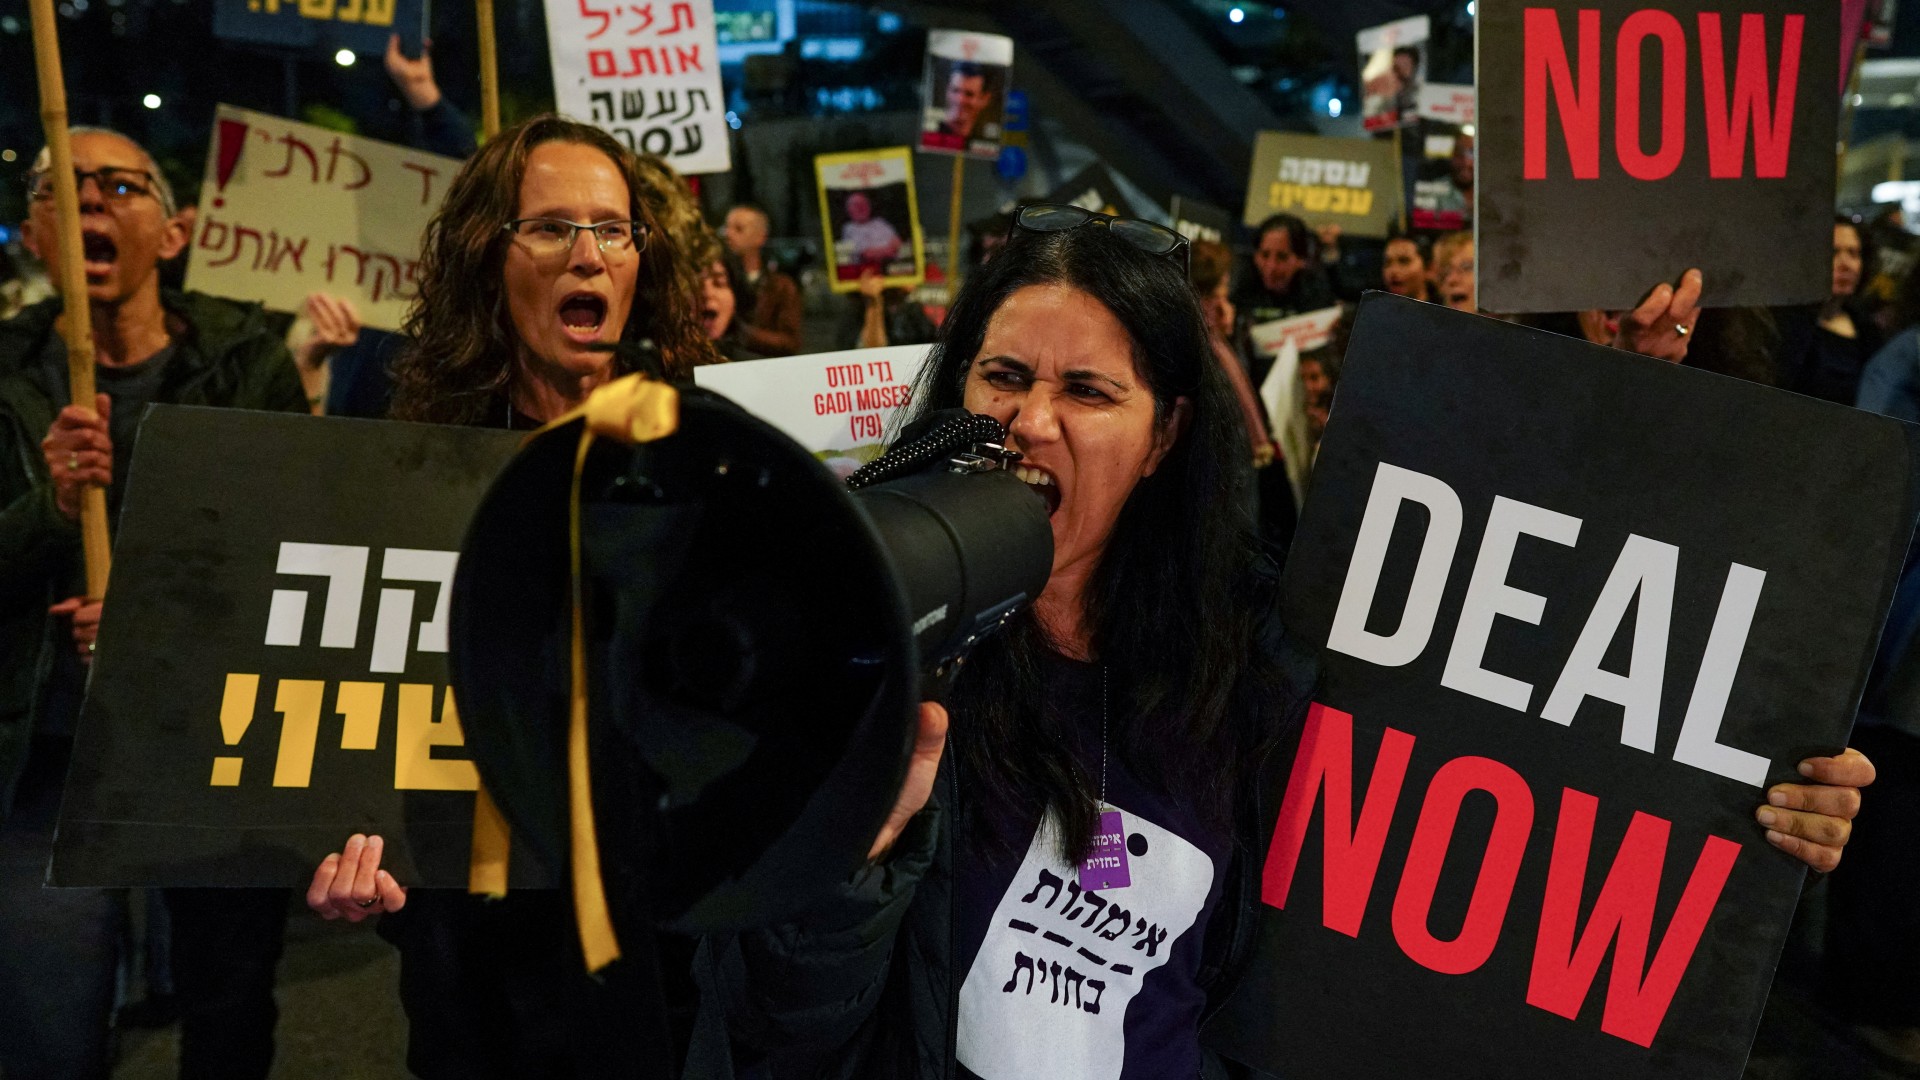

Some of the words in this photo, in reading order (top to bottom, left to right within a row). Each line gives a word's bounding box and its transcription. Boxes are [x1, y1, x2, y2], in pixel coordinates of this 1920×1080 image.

[578, 0, 696, 40] תציל
[589, 88, 710, 124] תעשה
[1523, 8, 1805, 181] NOW
[198, 215, 309, 273] אותם
[826, 364, 864, 388] מוזס
[867, 361, 893, 383] גדי
[814, 391, 852, 415] GADI
[856, 385, 911, 411] MOSES
[850, 413, 883, 441] (79)
[264, 541, 460, 673] קה
[1326, 461, 1771, 788] DEAL
[210, 673, 481, 791] שיו!
[1086, 856, 1120, 870] בחזית
[1090, 832, 1121, 846] אימה
[1261, 701, 1743, 1048] NOW
[1021, 868, 1167, 957] אימהות
[1002, 951, 1106, 1014] בחזית
